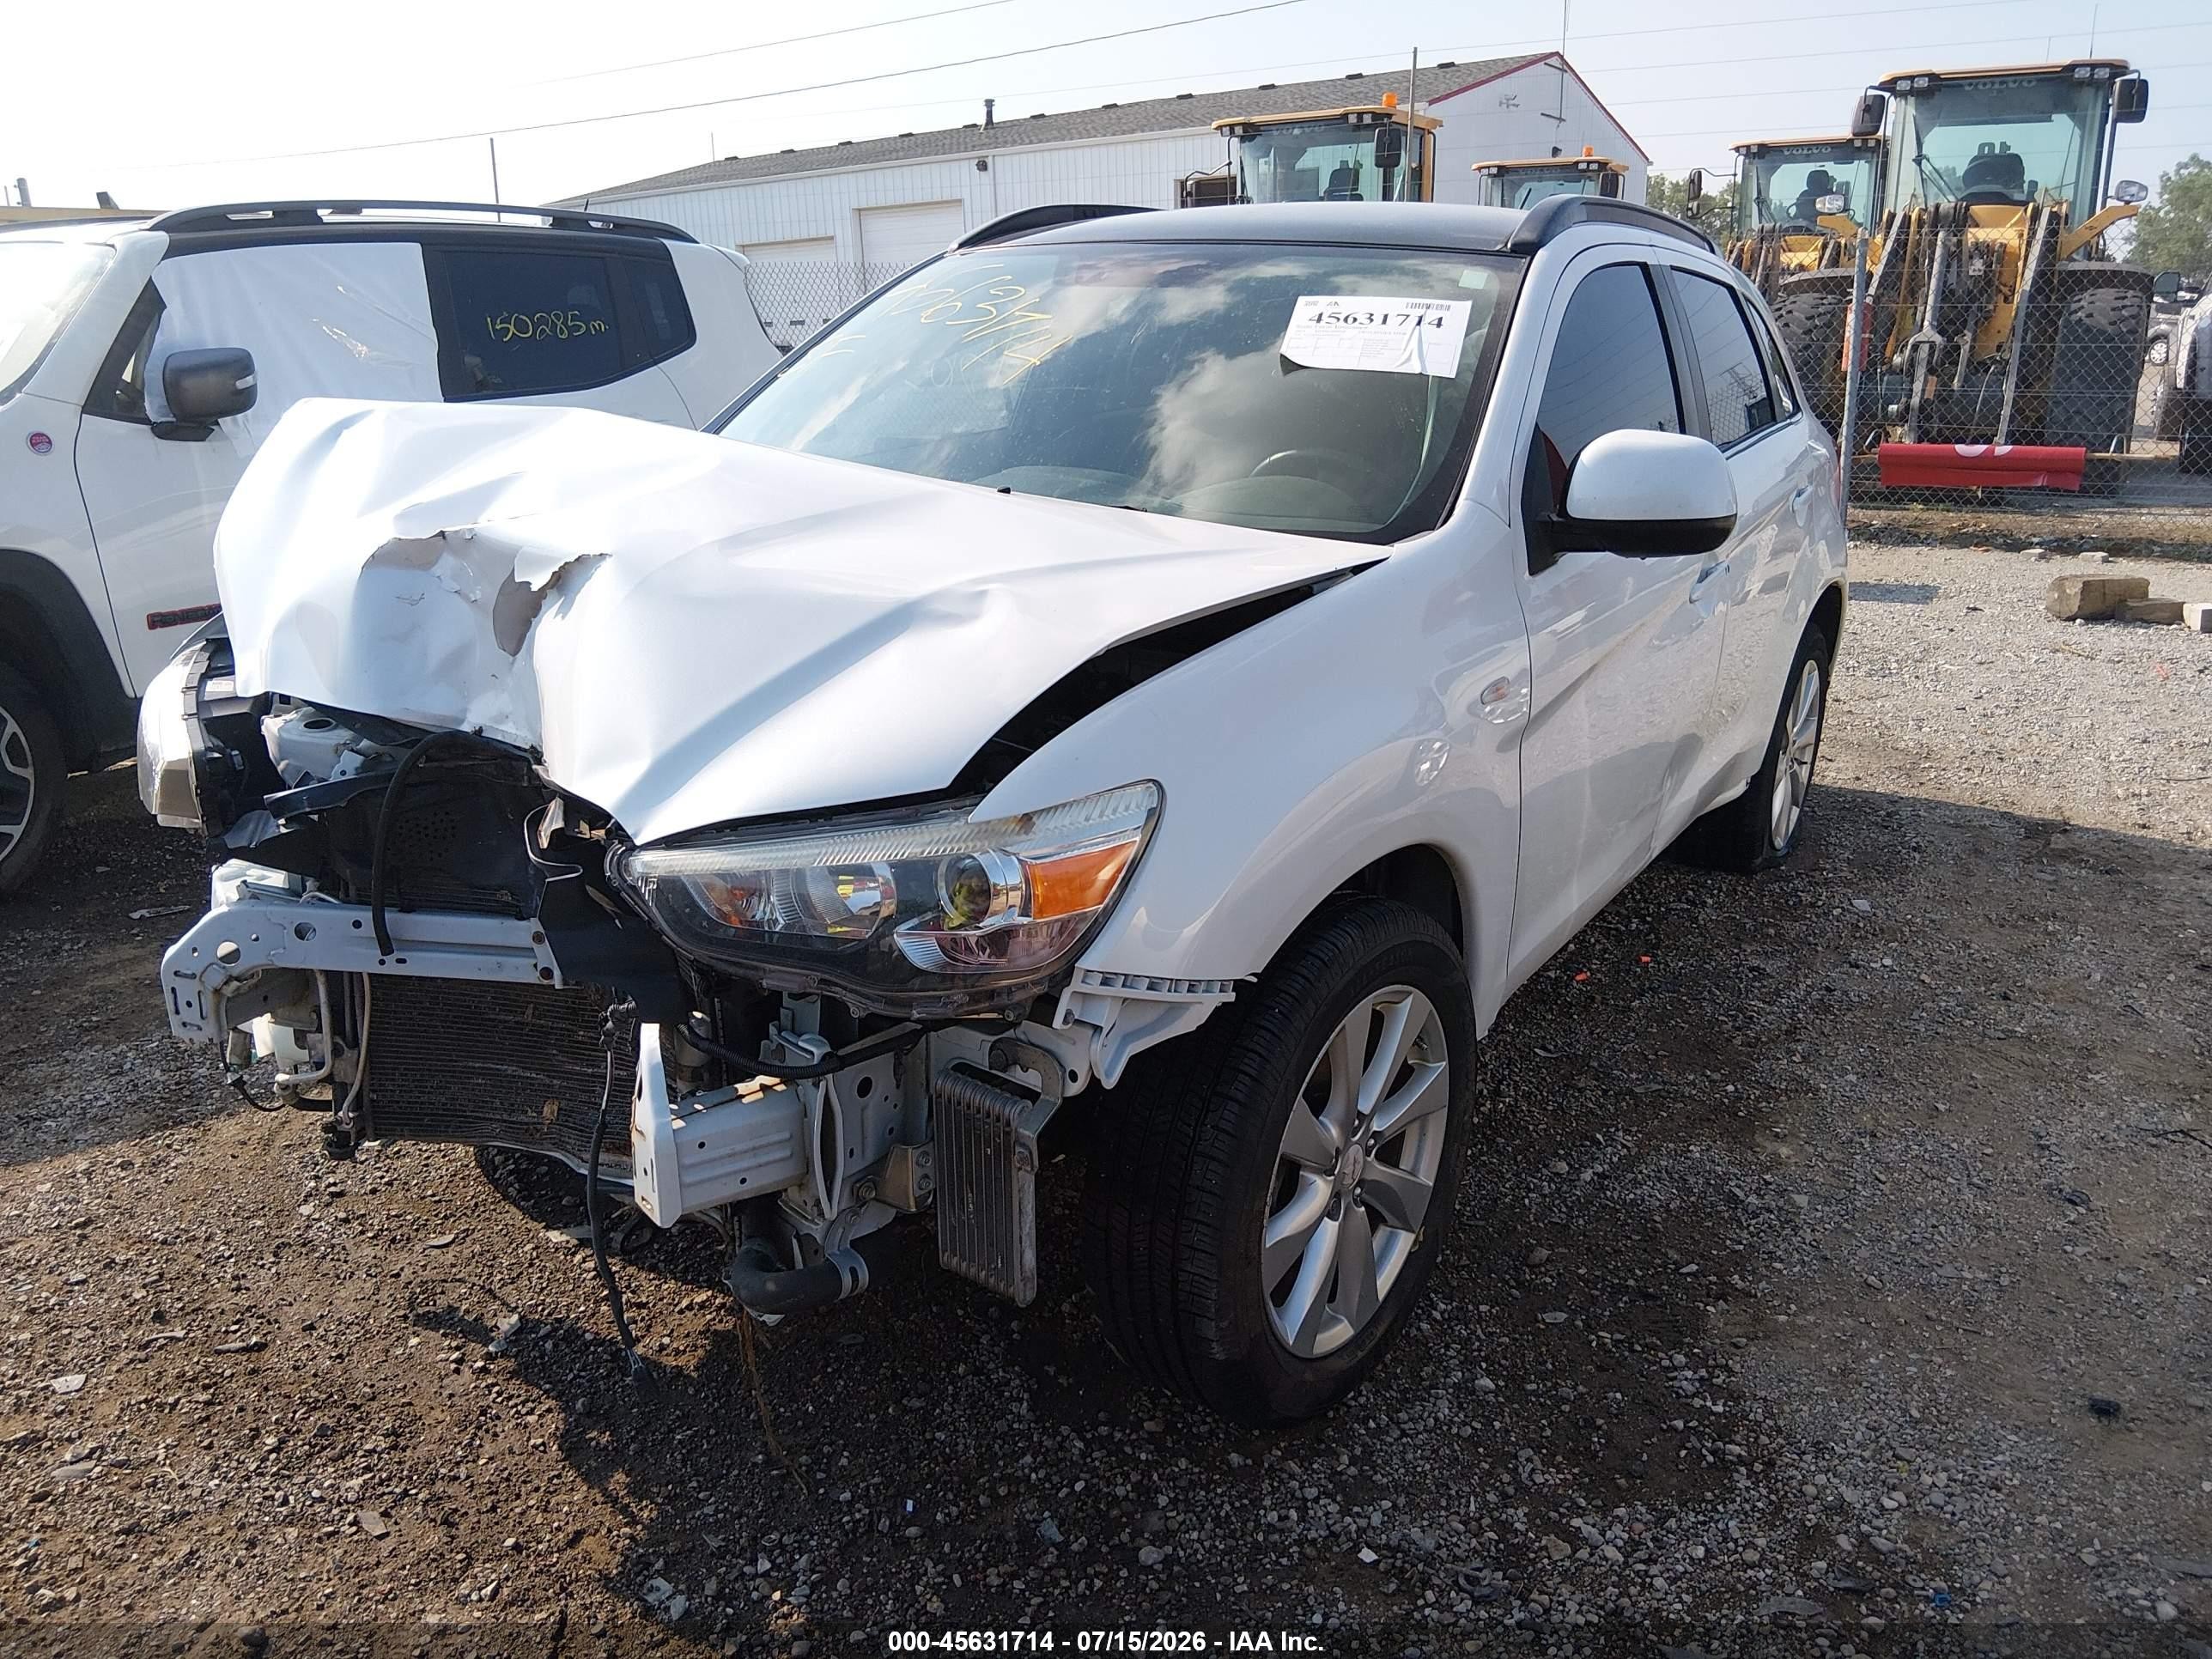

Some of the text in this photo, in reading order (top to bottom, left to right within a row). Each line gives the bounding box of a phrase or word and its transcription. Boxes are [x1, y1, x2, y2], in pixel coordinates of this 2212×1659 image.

[1964, 77, 2037, 90] VOLVO
[1783, 145, 1832, 155] VOLVO
[1309, 311, 1443, 329] 45631714
